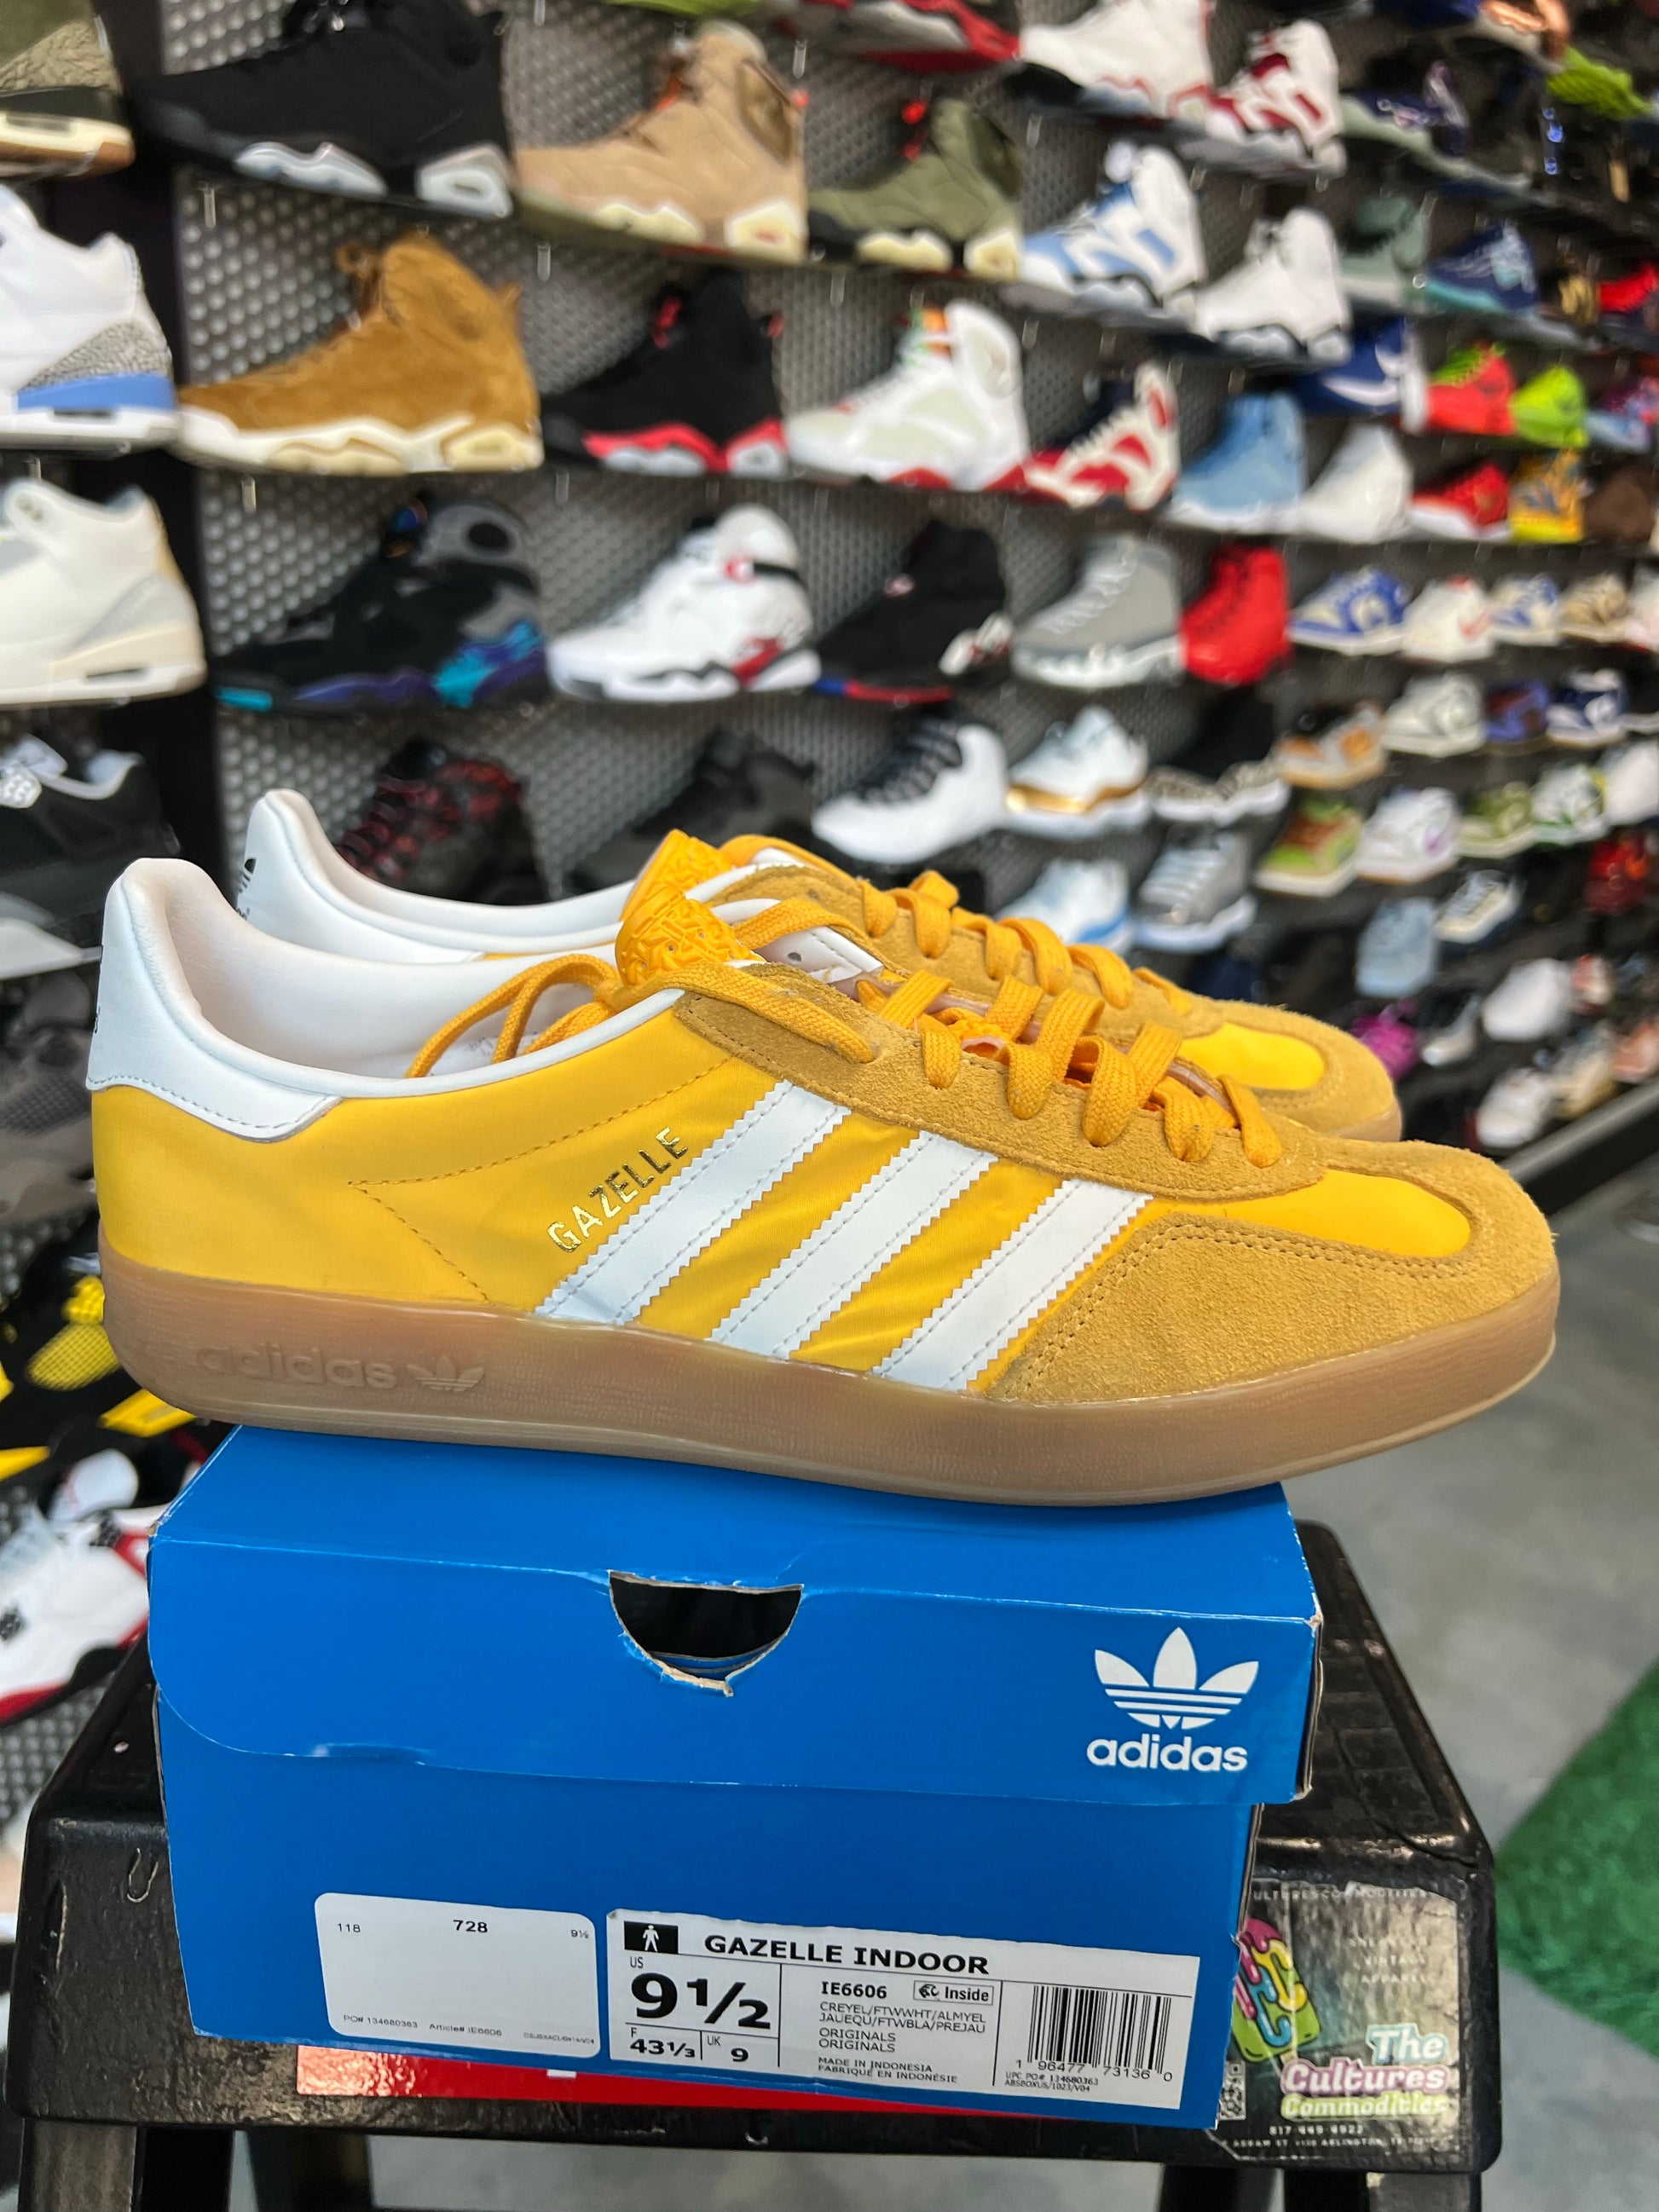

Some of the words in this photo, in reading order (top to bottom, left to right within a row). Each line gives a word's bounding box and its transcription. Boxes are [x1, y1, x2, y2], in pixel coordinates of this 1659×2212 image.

[546, 1126, 689, 1253] GAZELLE
[195, 1342, 397, 1389] adidas
[1086, 1733, 1248, 1771] adidas
[338, 1923, 361, 1933] 118
[453, 1919, 488, 1933] 728
[629, 1956, 645, 1969] US
[704, 1935, 843, 1963] GAZELLE
[853, 1947, 990, 1974] INDOOR
[821, 1981, 887, 1999] IE6606
[945, 1986, 990, 2002] Inside
[819, 2001, 986, 2024] CREYEL/FTWWHT/ALMYEL
[344, 2014, 364, 2024] PO#
[429, 2023, 465, 2033] Article#
[818, 2013, 986, 2034] JAUEQU/FTWBLA/PREJAU
[630, 2027, 638, 2038] F
[818, 2027, 896, 2042] ORIGINALS
[707, 2036, 721, 2047] UK
[818, 2038, 895, 2053] ORIGINALS
[1372, 2029, 1445, 2061] The
[731, 2047, 749, 2063] 9
[818, 2057, 851, 2066] MADE
[854, 2059, 866, 2069] IN
[871, 2061, 933, 2073] INDONESIA
[1016, 2059, 1022, 2069] 1
[1038, 2061, 1085, 2074] 96477
[1103, 2066, 1151, 2080] 73136
[1164, 2071, 1173, 2082] 0
[877, 2070, 892, 2079] EN
[1006, 2071, 1023, 2080] UPC
[1284, 2059, 1446, 2094] Cultures
[1284, 2094, 1447, 2117] Commodities
